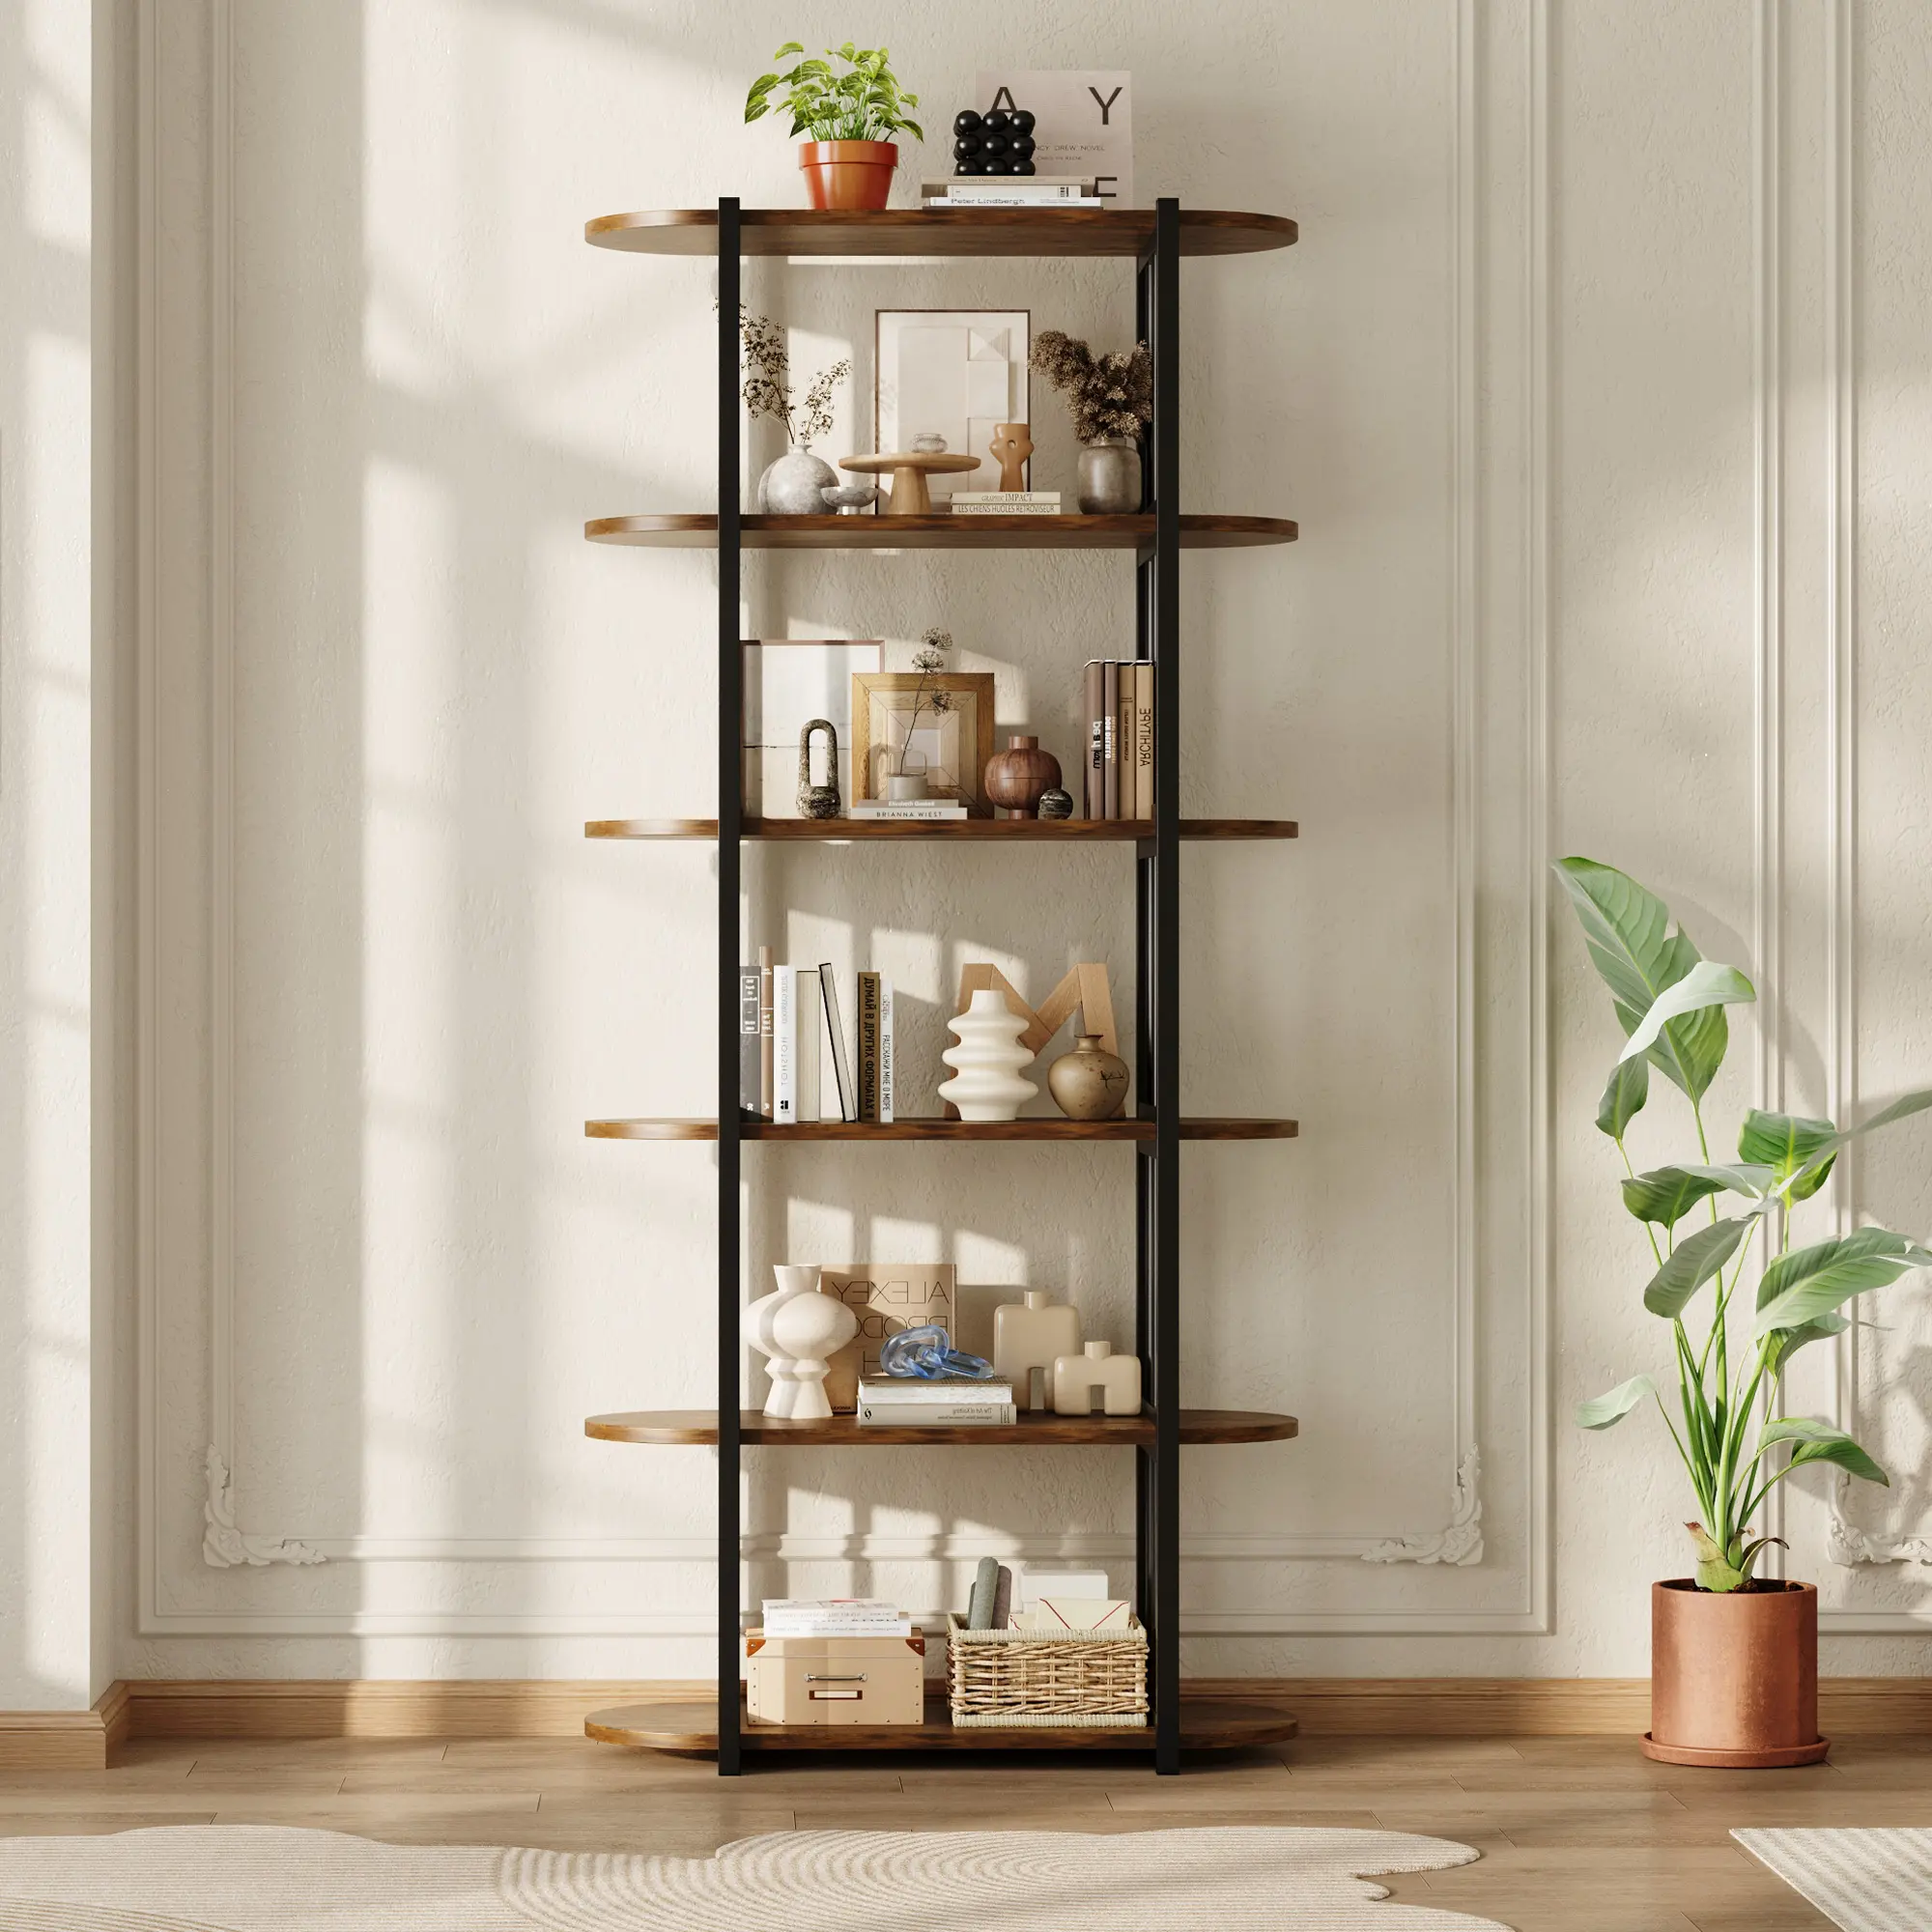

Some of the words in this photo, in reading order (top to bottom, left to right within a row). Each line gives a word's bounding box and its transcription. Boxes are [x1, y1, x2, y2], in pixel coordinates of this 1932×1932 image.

[1088, 86, 1123, 126] Y
[1005, 493, 1033, 502] IMPACT
[864, 977, 876, 1009] ДУМАЙ
[864, 1021, 875, 1058] ДРУГИХ
[882, 1035, 891, 1069] РАССКАЖИ
[864, 1060, 875, 1110] ФОРМАТАХ
[882, 1071, 891, 1085] МНЕ
[882, 1093, 891, 1111] МОРЕ
